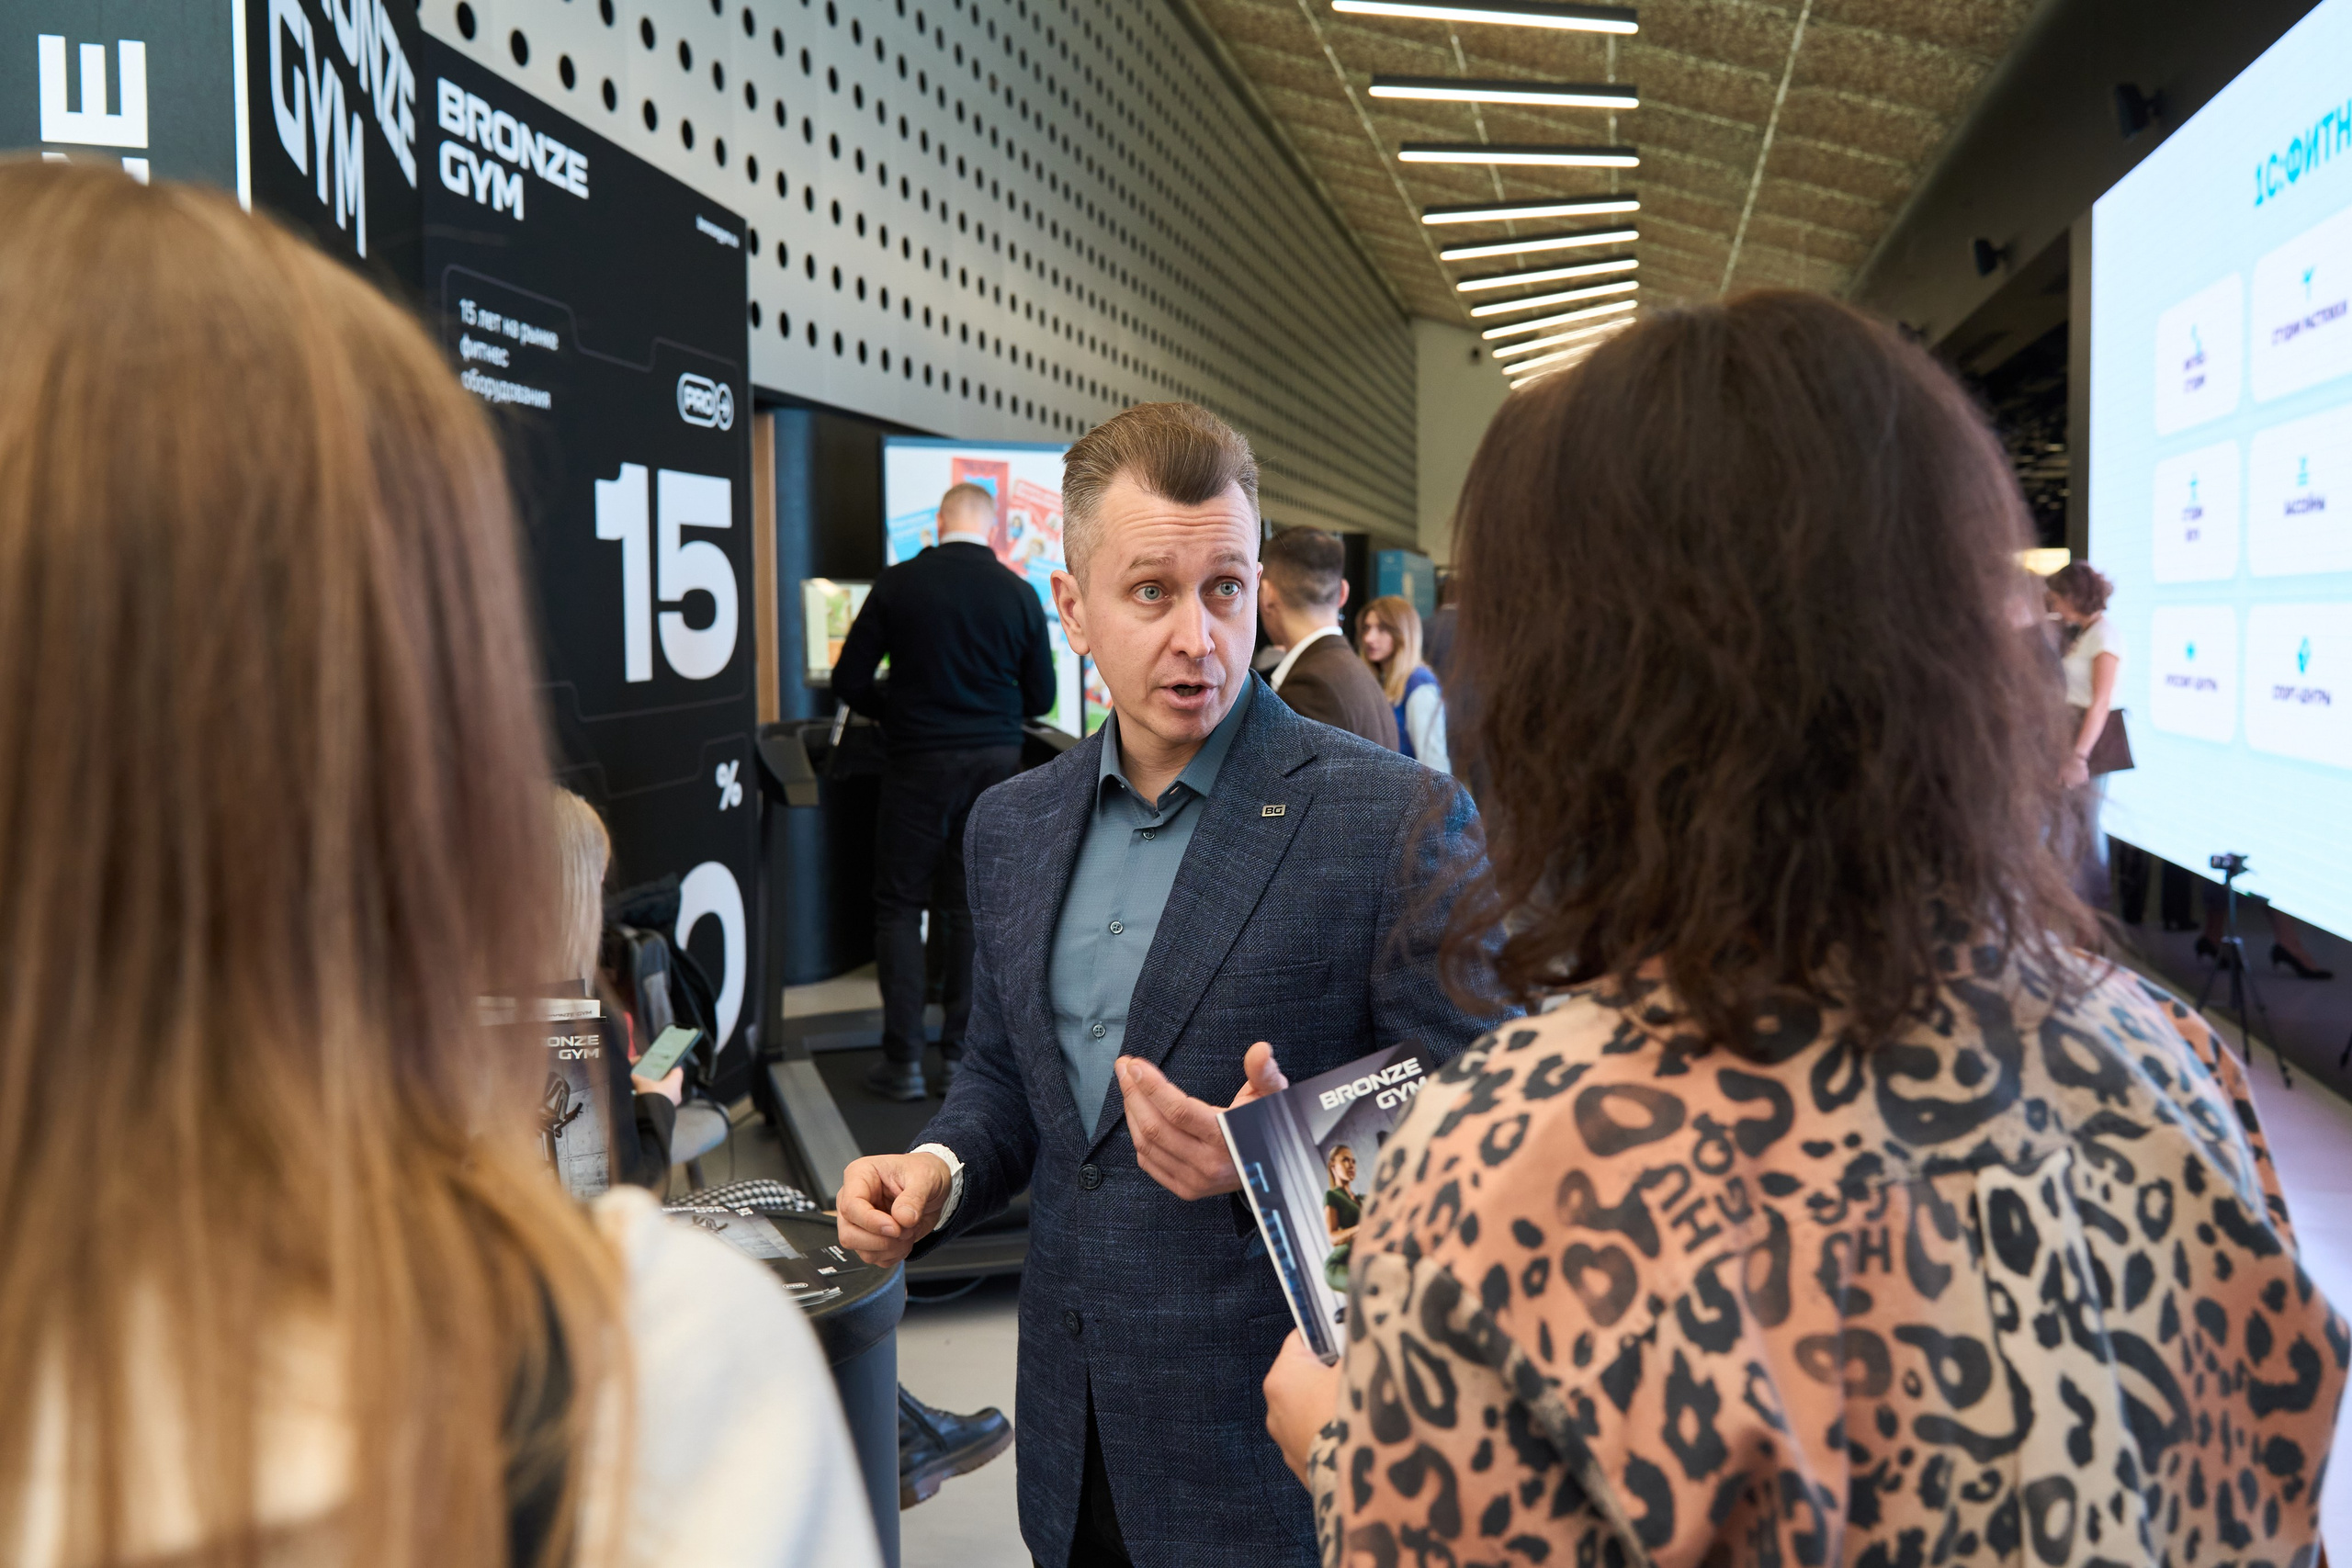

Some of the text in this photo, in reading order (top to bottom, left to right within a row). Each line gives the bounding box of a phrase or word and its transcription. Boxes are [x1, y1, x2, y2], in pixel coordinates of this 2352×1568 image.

[437, 76, 589, 199] BRONZE
[439, 140, 524, 220] GYM
[459, 298, 477, 325] 15
[595, 462, 739, 682] 15
[1264, 807, 1283, 815] BG
[558, 1048, 600, 1060] GYM
[1318, 1056, 1423, 1111] BRONZE
